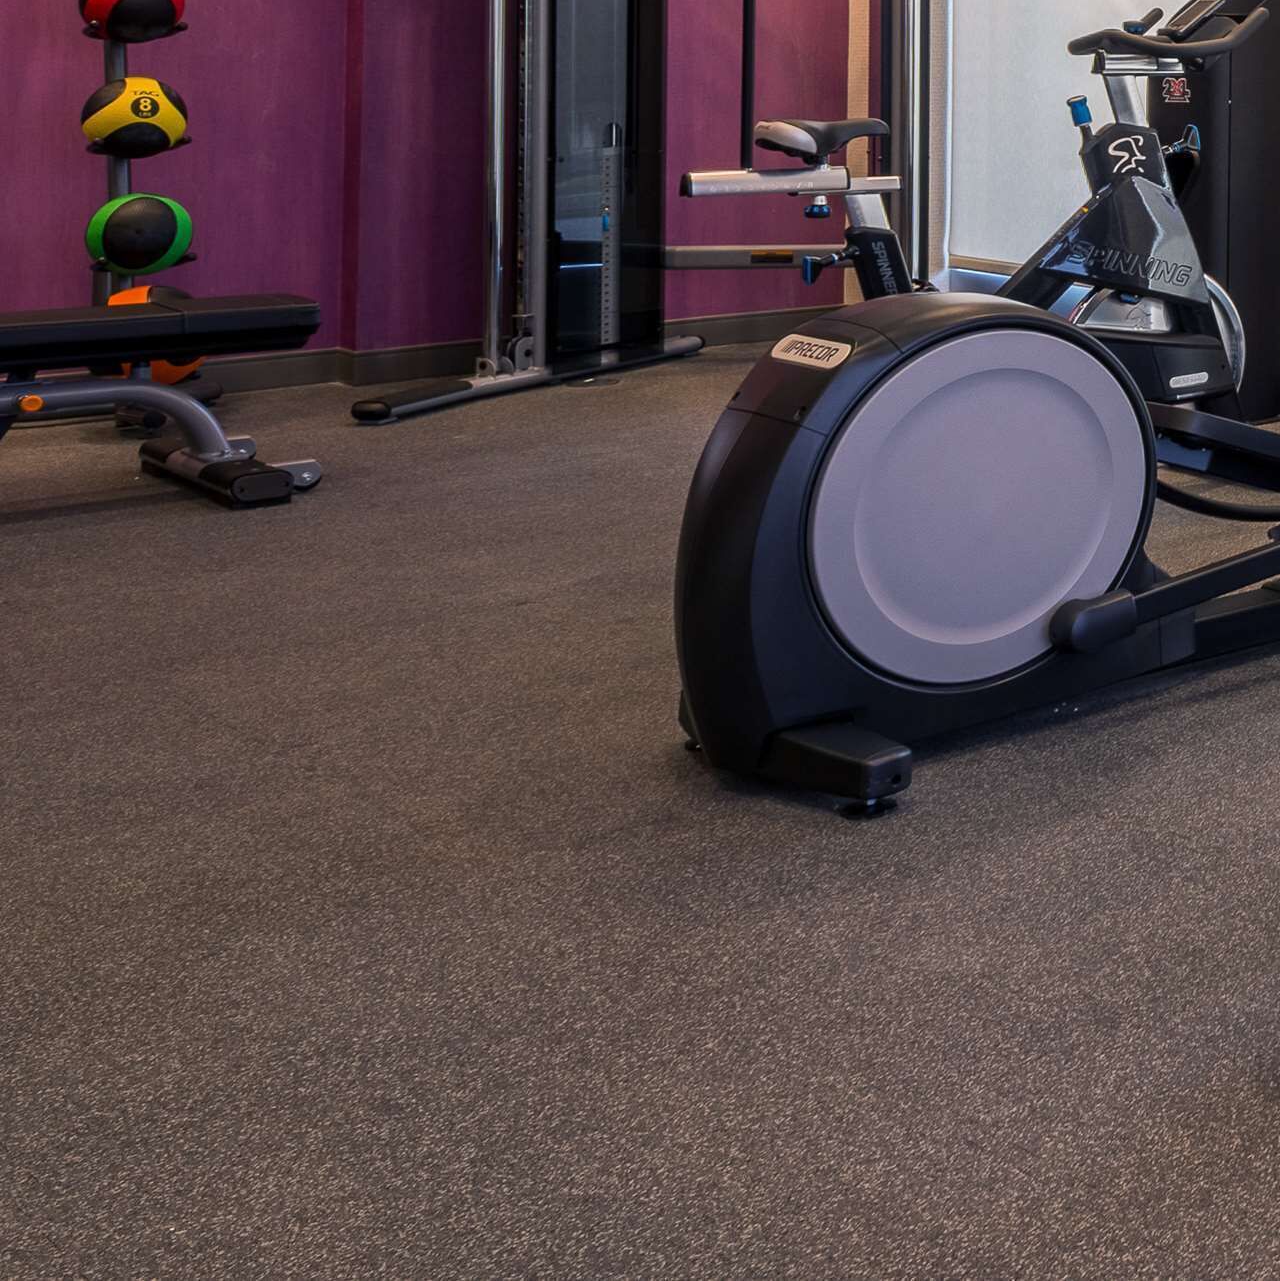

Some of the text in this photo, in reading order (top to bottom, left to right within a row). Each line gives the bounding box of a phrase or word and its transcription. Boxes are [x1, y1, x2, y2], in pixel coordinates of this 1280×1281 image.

[140, 98, 151, 111] 8
[1067, 240, 1193, 287] SPINNING
[786, 340, 840, 362] PRECOR
